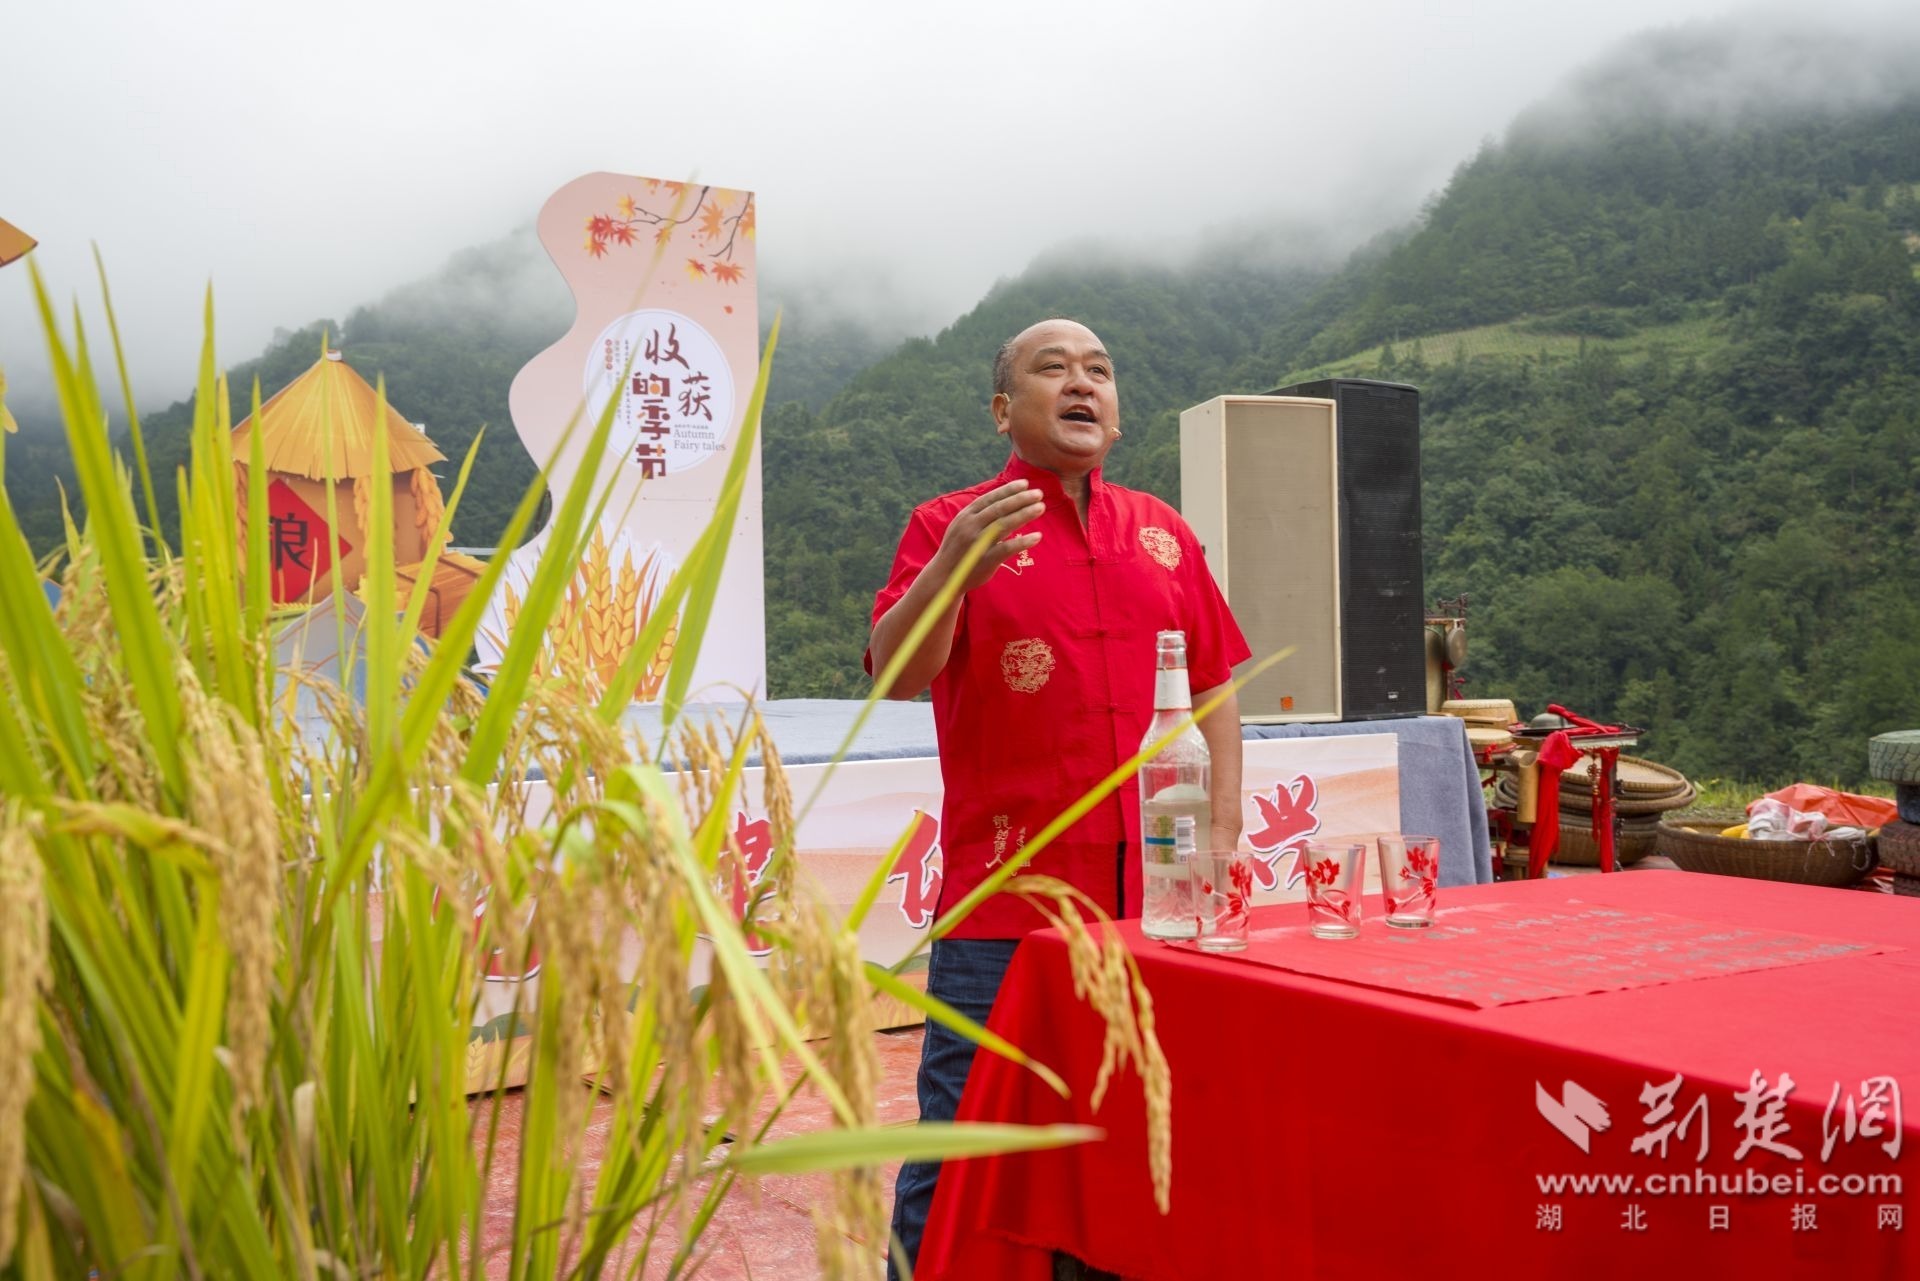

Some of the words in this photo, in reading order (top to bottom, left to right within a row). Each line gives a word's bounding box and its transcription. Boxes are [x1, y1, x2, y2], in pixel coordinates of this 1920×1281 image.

[673, 429, 715, 439] Autumn
[674, 439, 699, 453] Fairy
[702, 440, 726, 451] tales
